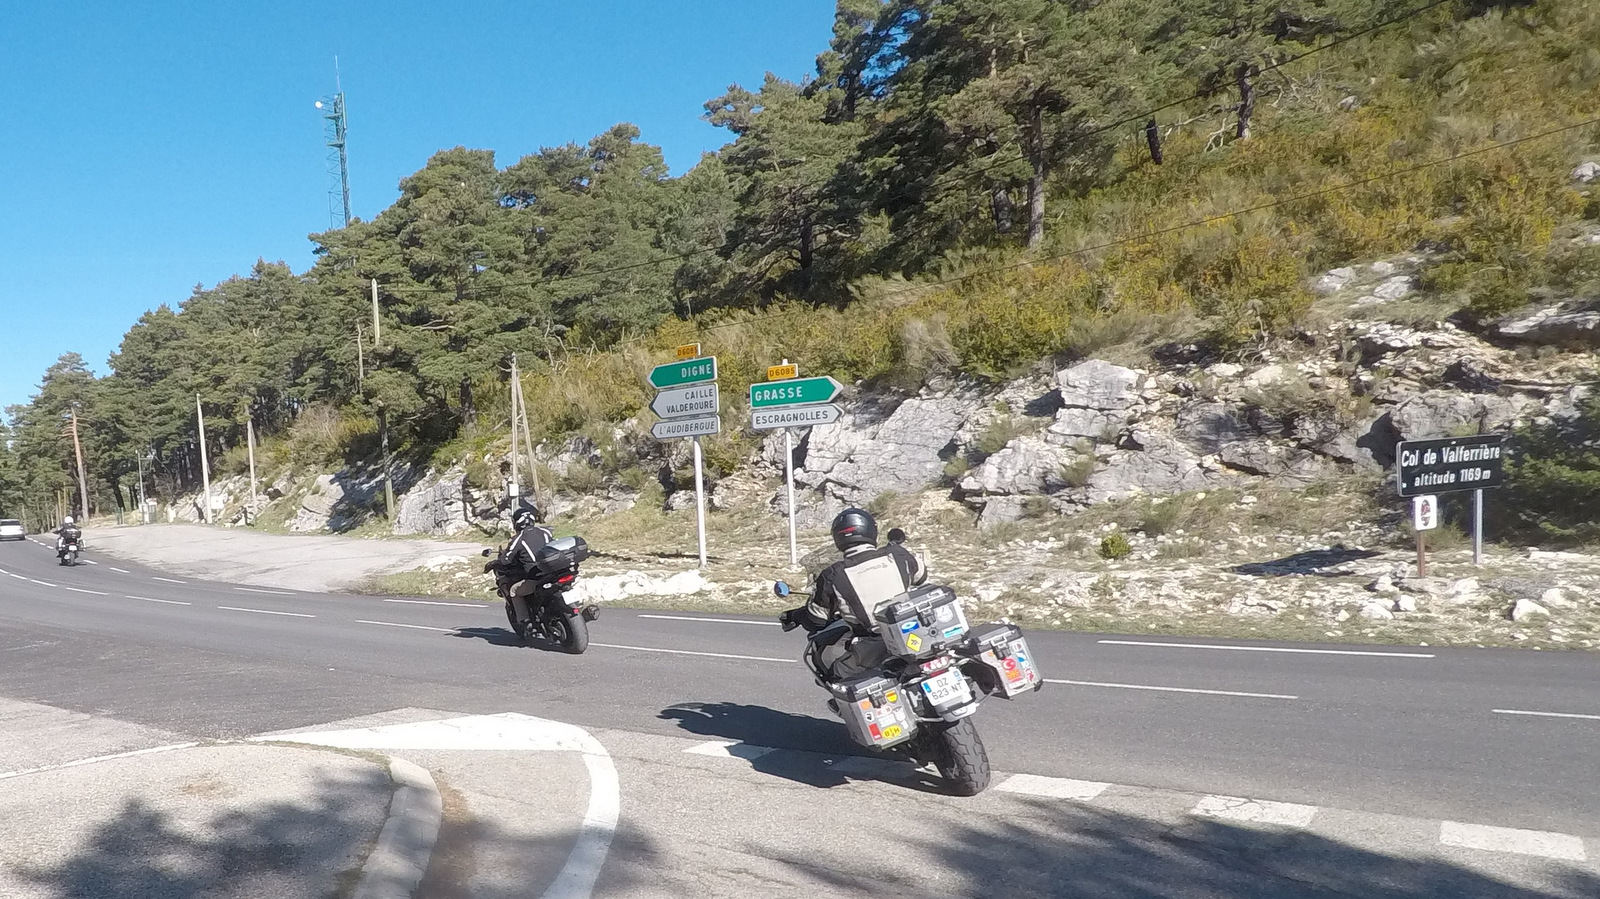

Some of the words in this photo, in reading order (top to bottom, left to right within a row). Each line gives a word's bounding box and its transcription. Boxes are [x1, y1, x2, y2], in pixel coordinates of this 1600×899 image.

[681, 363, 712, 379] DIGNE
[769, 366, 795, 377] D6085
[684, 388, 714, 400] CAILLE
[755, 386, 803, 402] GRASSE
[666, 400, 714, 414] VALDEROURE
[755, 410, 829, 425] ESCRAGNOLLES
[659, 421, 715, 435] L'AUDIBERGUE
[1401, 449, 1419, 467] Col
[1423, 448, 1437, 465] de
[1442, 444, 1500, 463] Valferrière
[1414, 470, 1455, 487] altitude
[1460, 467, 1481, 482] 1169
[936, 677, 949, 688] DZ
